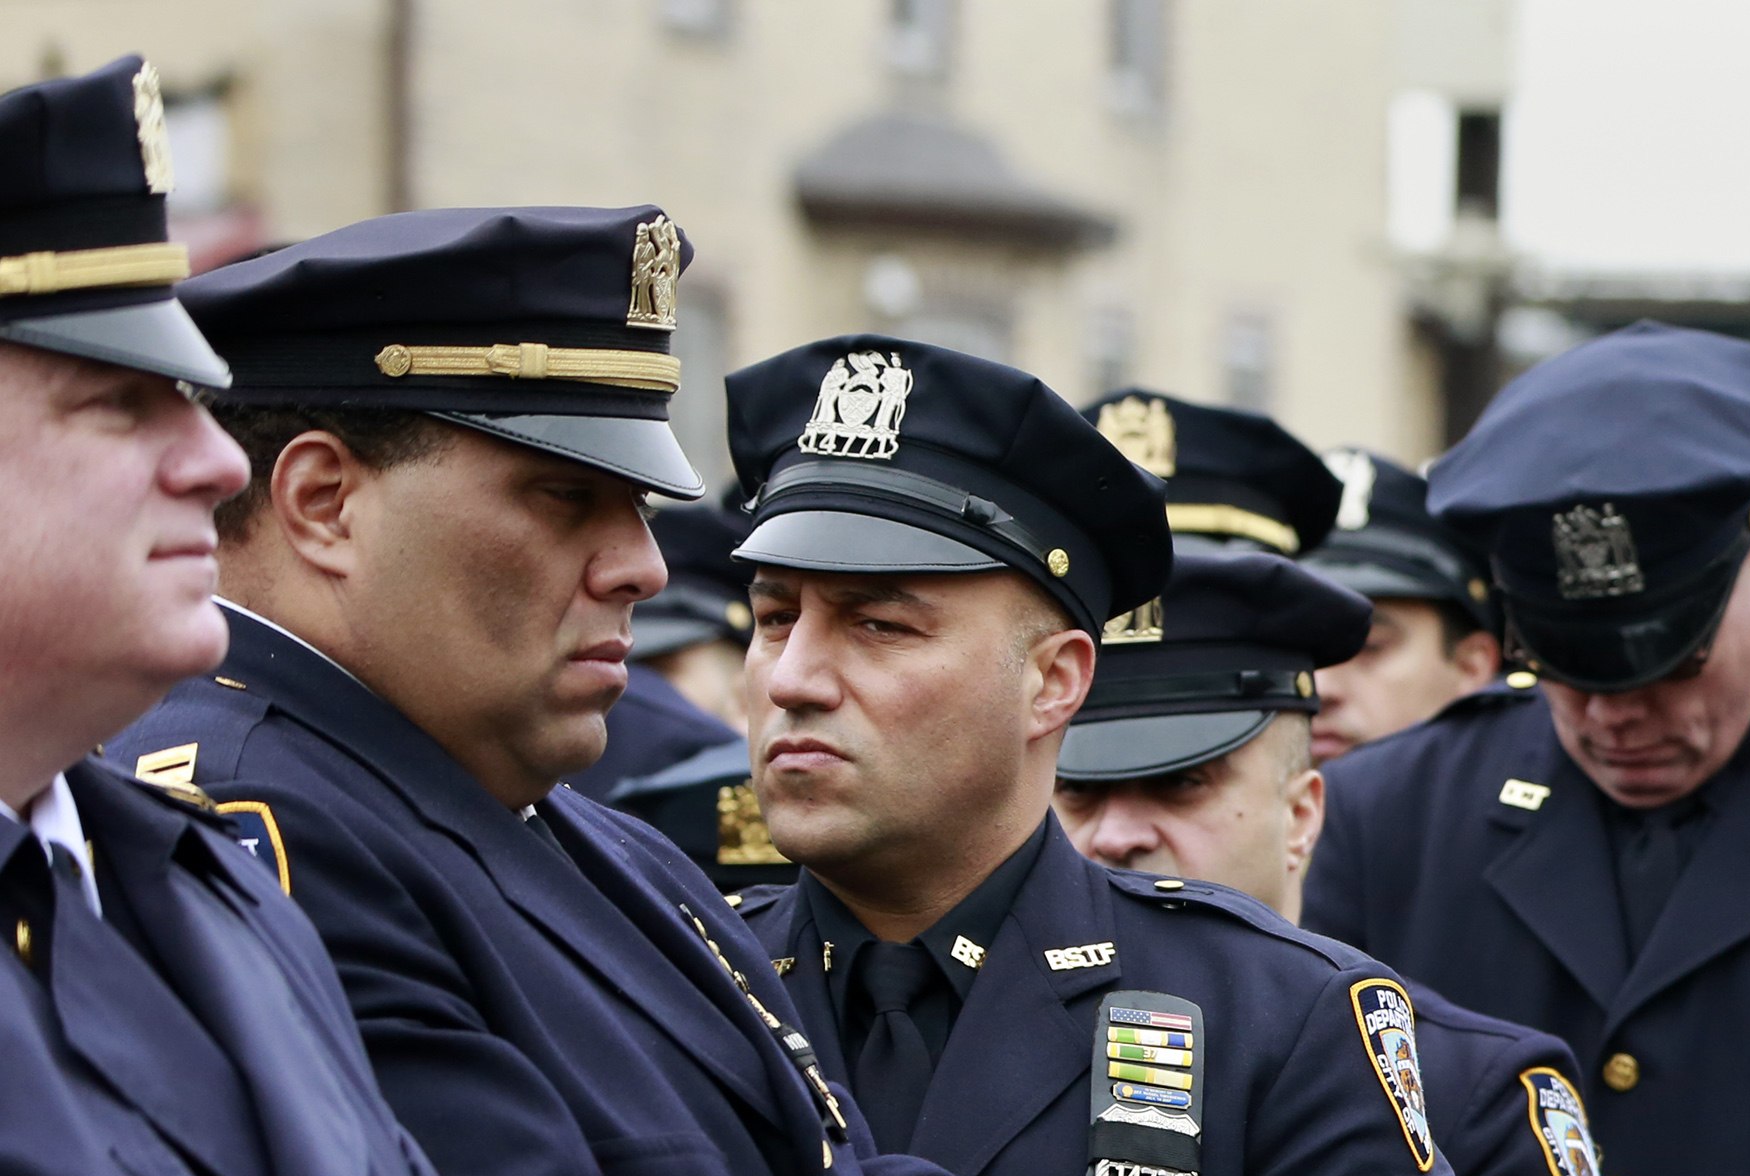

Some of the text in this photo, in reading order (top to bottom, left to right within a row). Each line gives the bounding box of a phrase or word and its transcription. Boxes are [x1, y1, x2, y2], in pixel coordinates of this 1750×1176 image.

[804, 428, 891, 459] 14771
[1377, 1054, 1416, 1135] CITY OF
